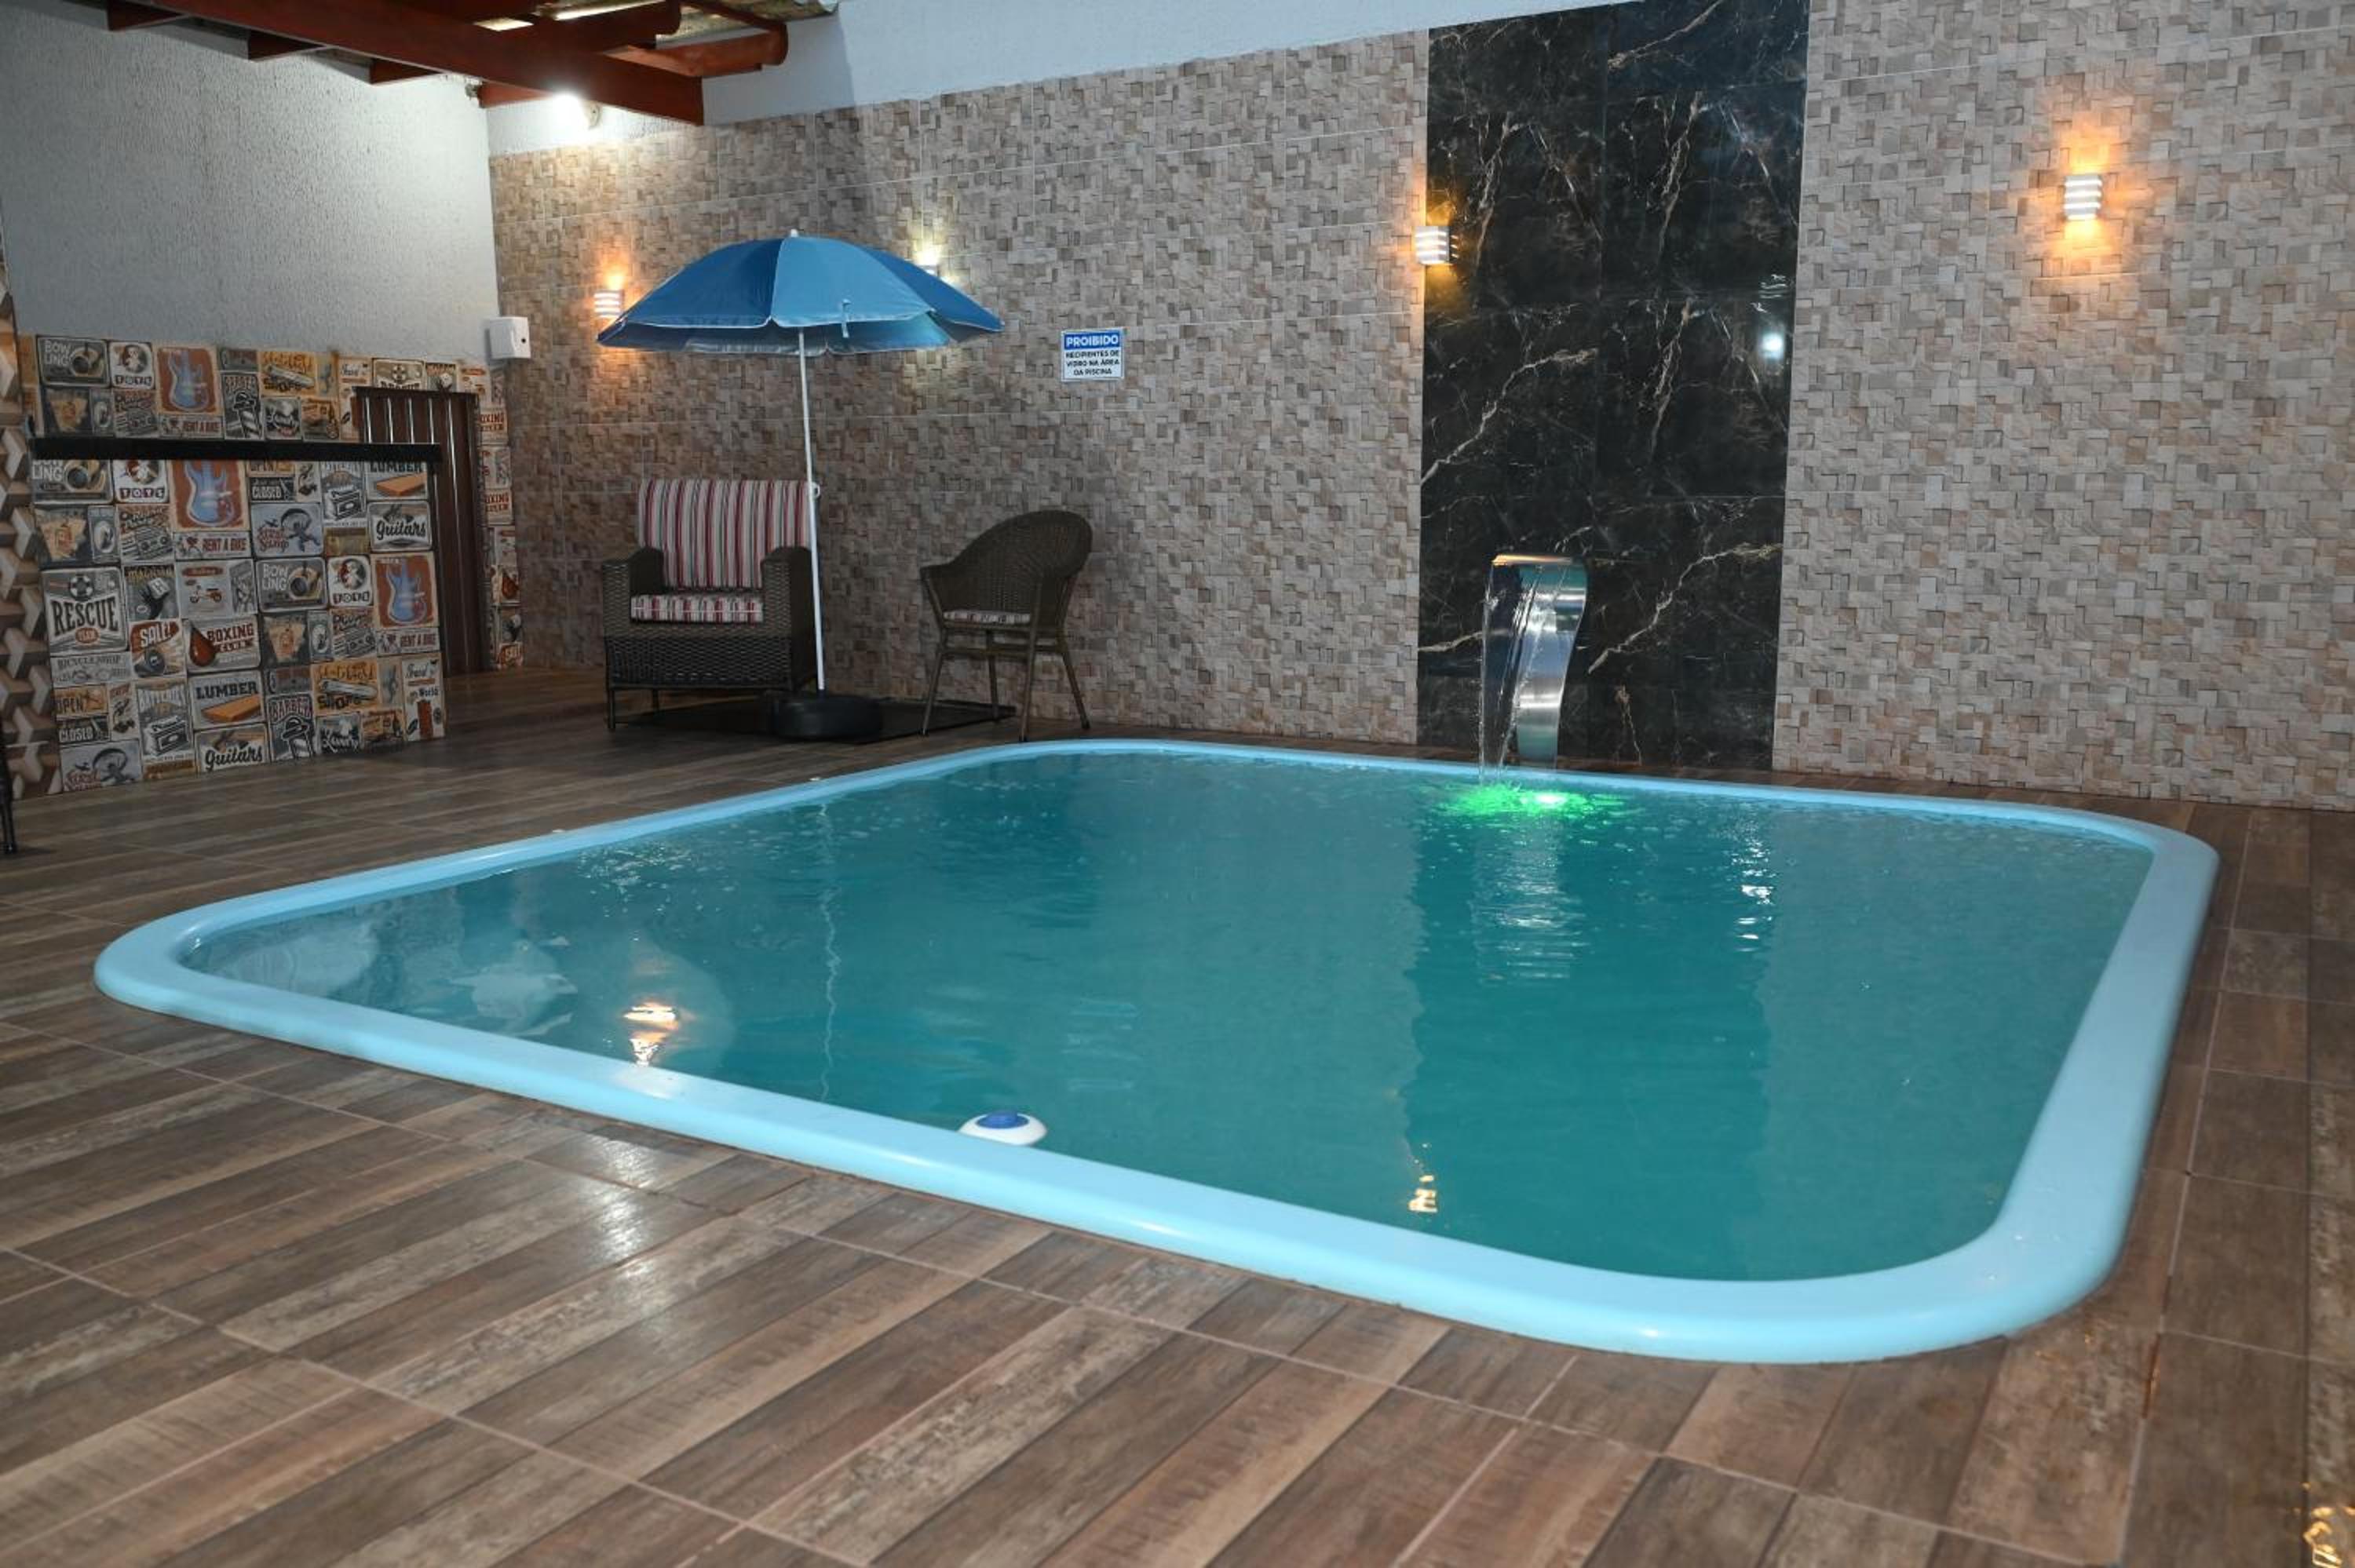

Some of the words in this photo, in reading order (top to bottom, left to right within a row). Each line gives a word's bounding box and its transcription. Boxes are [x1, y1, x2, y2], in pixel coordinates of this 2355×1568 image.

[44, 340, 71, 352] BOW
[1066, 335, 1119, 347] PROIBIDO
[44, 353, 69, 366] LING
[478, 412, 504, 422] OXING
[122, 488, 165, 498] TOYS
[203, 538, 221, 551] RENT
[223, 538, 228, 550] A
[230, 538, 246, 551] BIKE
[263, 563, 289, 578] BOW
[262, 578, 287, 591] LING
[53, 596, 119, 636] RESCUE
[206, 623, 254, 641] BOXING
[196, 681, 257, 699] LUMBER
